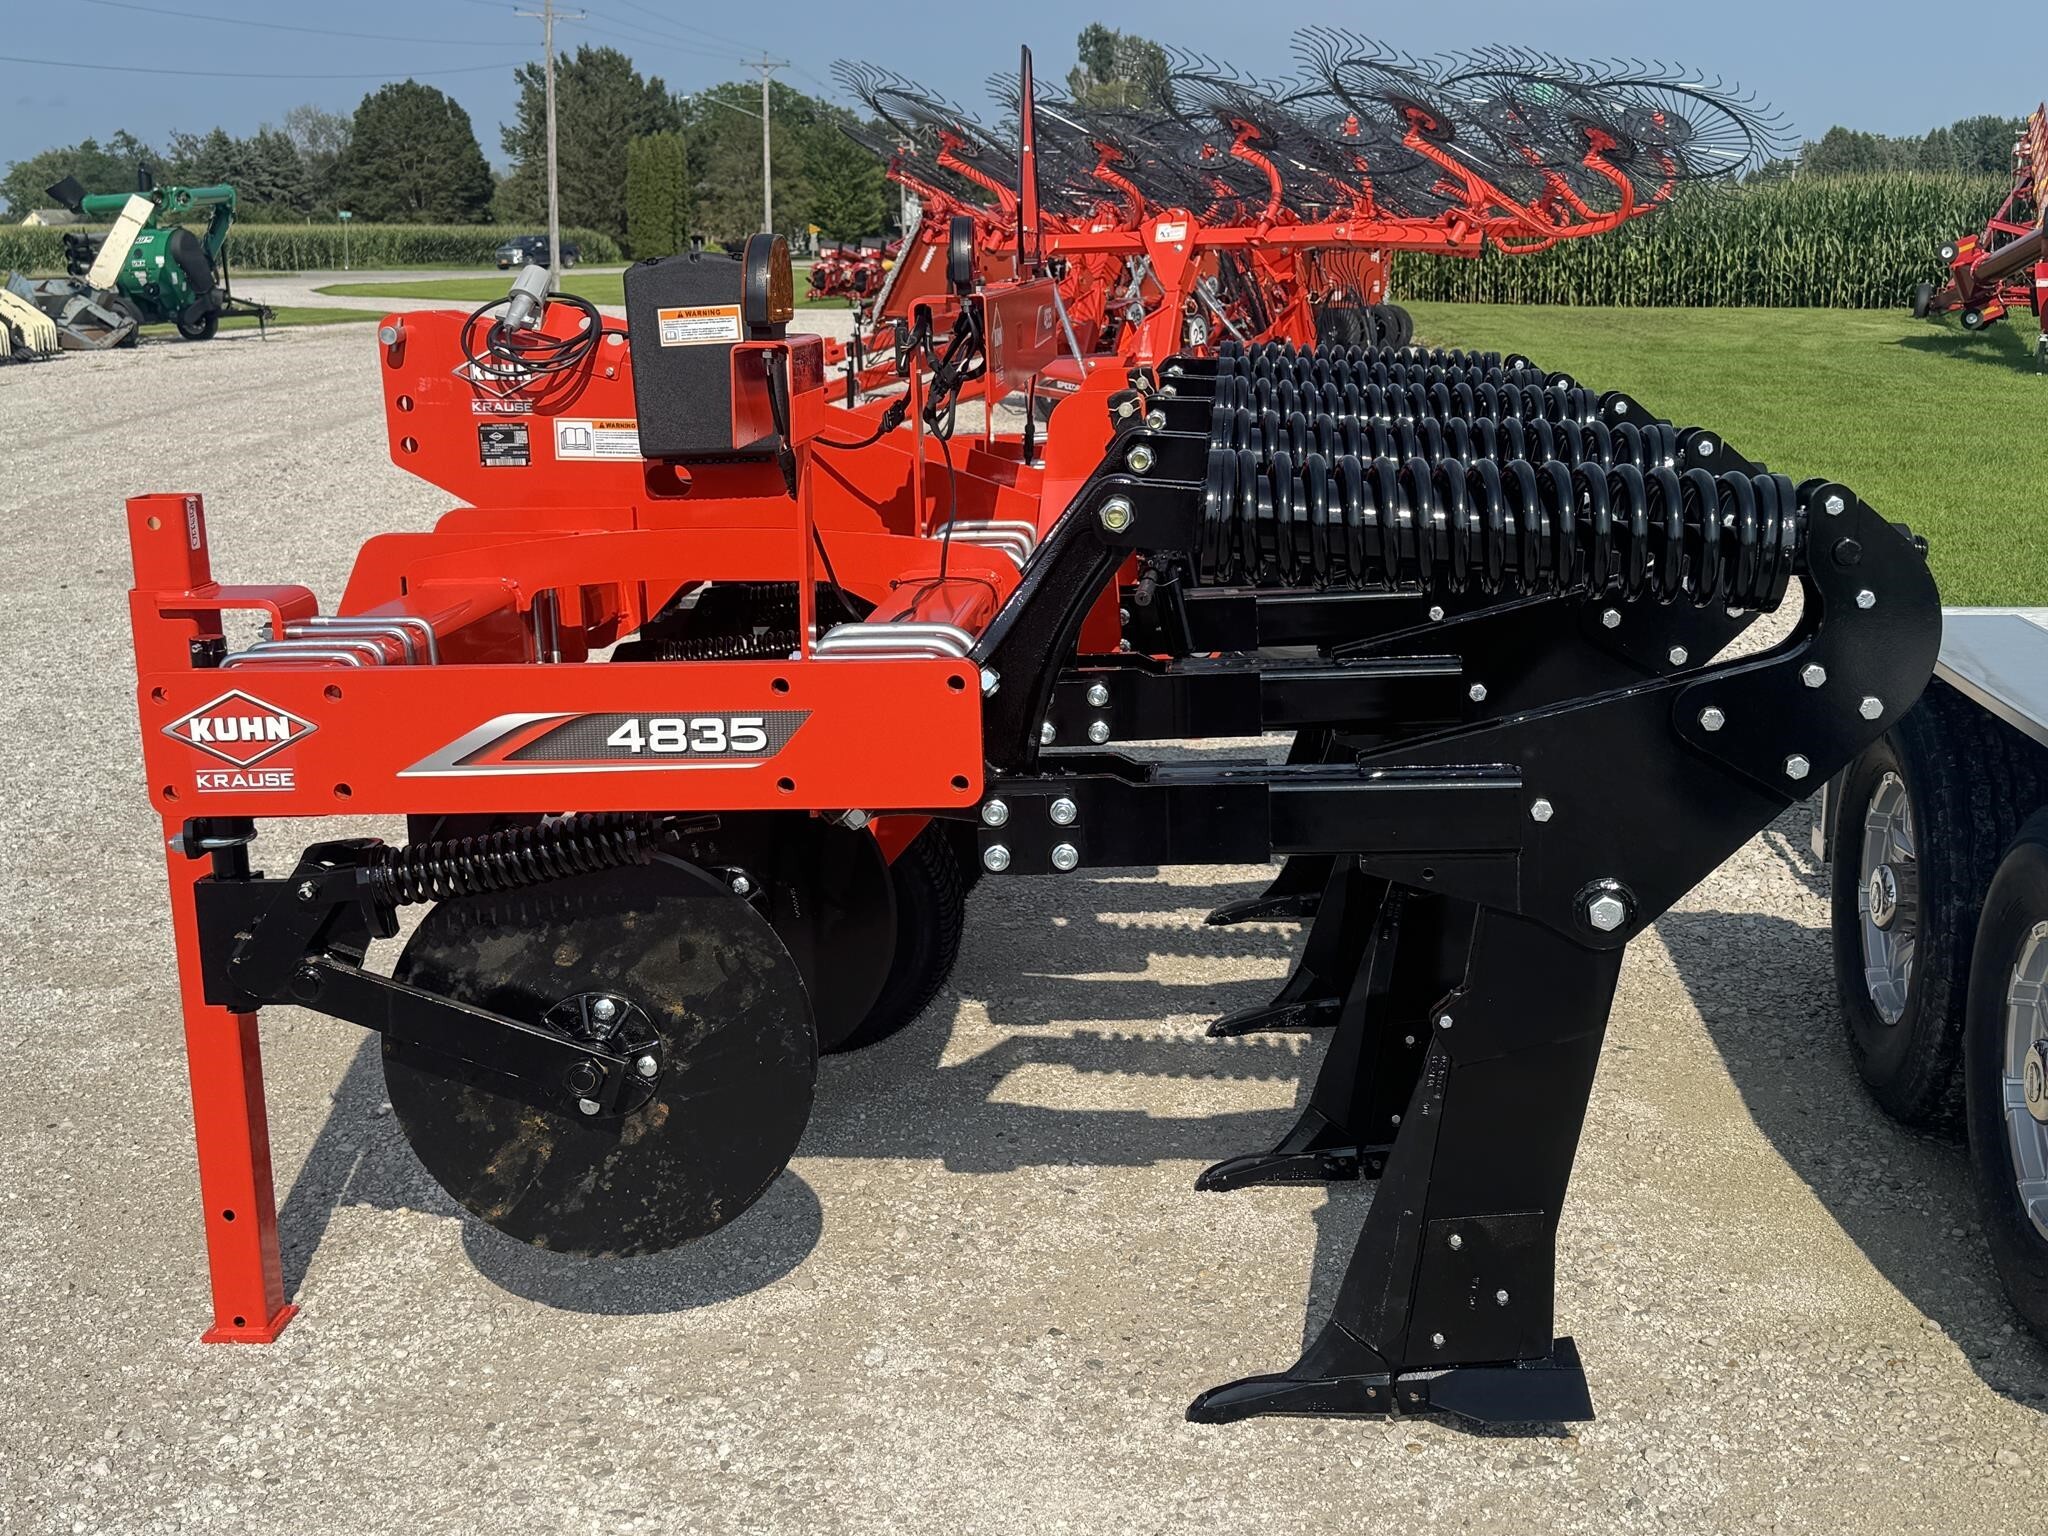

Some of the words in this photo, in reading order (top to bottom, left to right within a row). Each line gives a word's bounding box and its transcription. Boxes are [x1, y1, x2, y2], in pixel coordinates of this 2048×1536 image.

[685, 309, 721, 318] WARNING
[1193, 324, 1205, 343] 25
[471, 402, 533, 412] KRAUSE
[189, 716, 290, 742] KUHN
[607, 717, 768, 753] 4835
[196, 772, 295, 788] KRAUSE
